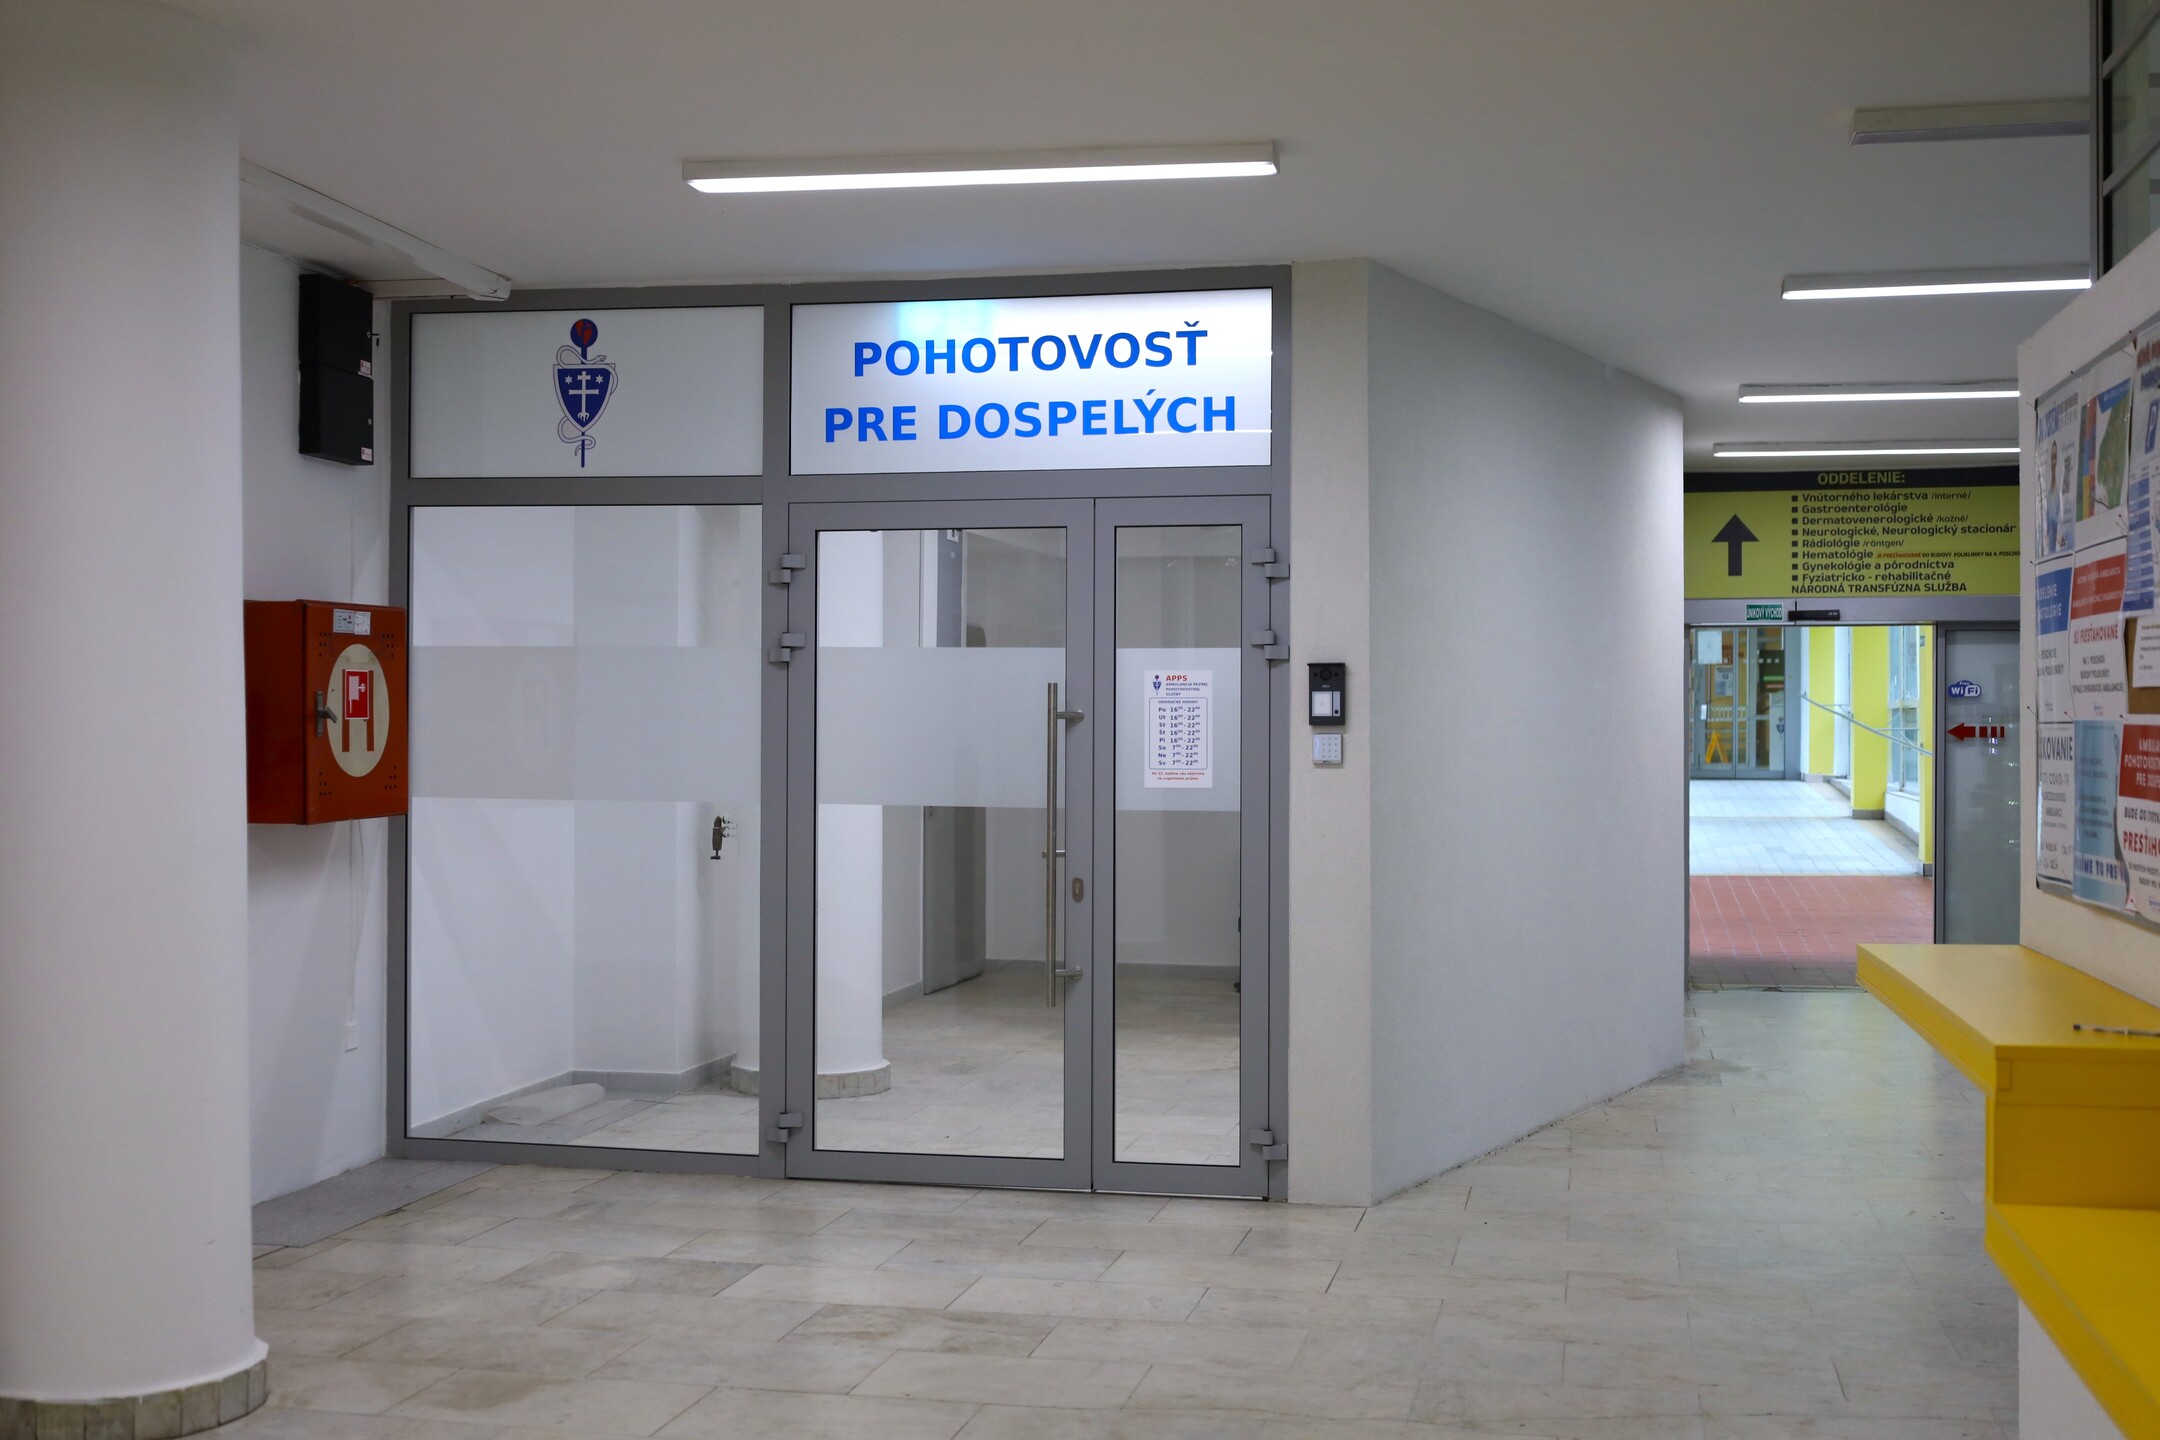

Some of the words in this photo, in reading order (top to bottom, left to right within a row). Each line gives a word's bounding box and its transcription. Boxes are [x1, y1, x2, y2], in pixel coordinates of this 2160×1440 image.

[854, 320, 1208, 377] POHOTOVOSŤ
[825, 405, 917, 442] PRE
[938, 389, 1236, 440] DOSPELÝCH
[1817, 471, 1905, 485] ODDELENIE:
[1802, 491, 1870, 502] Vnútorného
[1873, 490, 1928, 501] lekárstva
[1802, 502, 1908, 514] Gastroenterológie
[1802, 513, 1934, 525] Dermatovenerologické
[1802, 525, 1880, 537] Neurologické,
[1882, 524, 1958, 536] Neurologický
[1961, 522, 2017, 534] stacionár
[1802, 537, 1860, 549] Rádiológie
[1802, 549, 1873, 561] Hematológie
[1802, 560, 1872, 573] Gynekológie
[1884, 559, 1955, 571] pôrodníctva
[1802, 572, 1865, 584] Fyziatricko
[1875, 570, 1952, 581] rehabilitačné
[1792, 582, 1845, 594] NÁRODNÁ
[1848, 581, 1921, 593] TRANSFÚZNA
[1924, 580, 1967, 592] SLUŽBA
